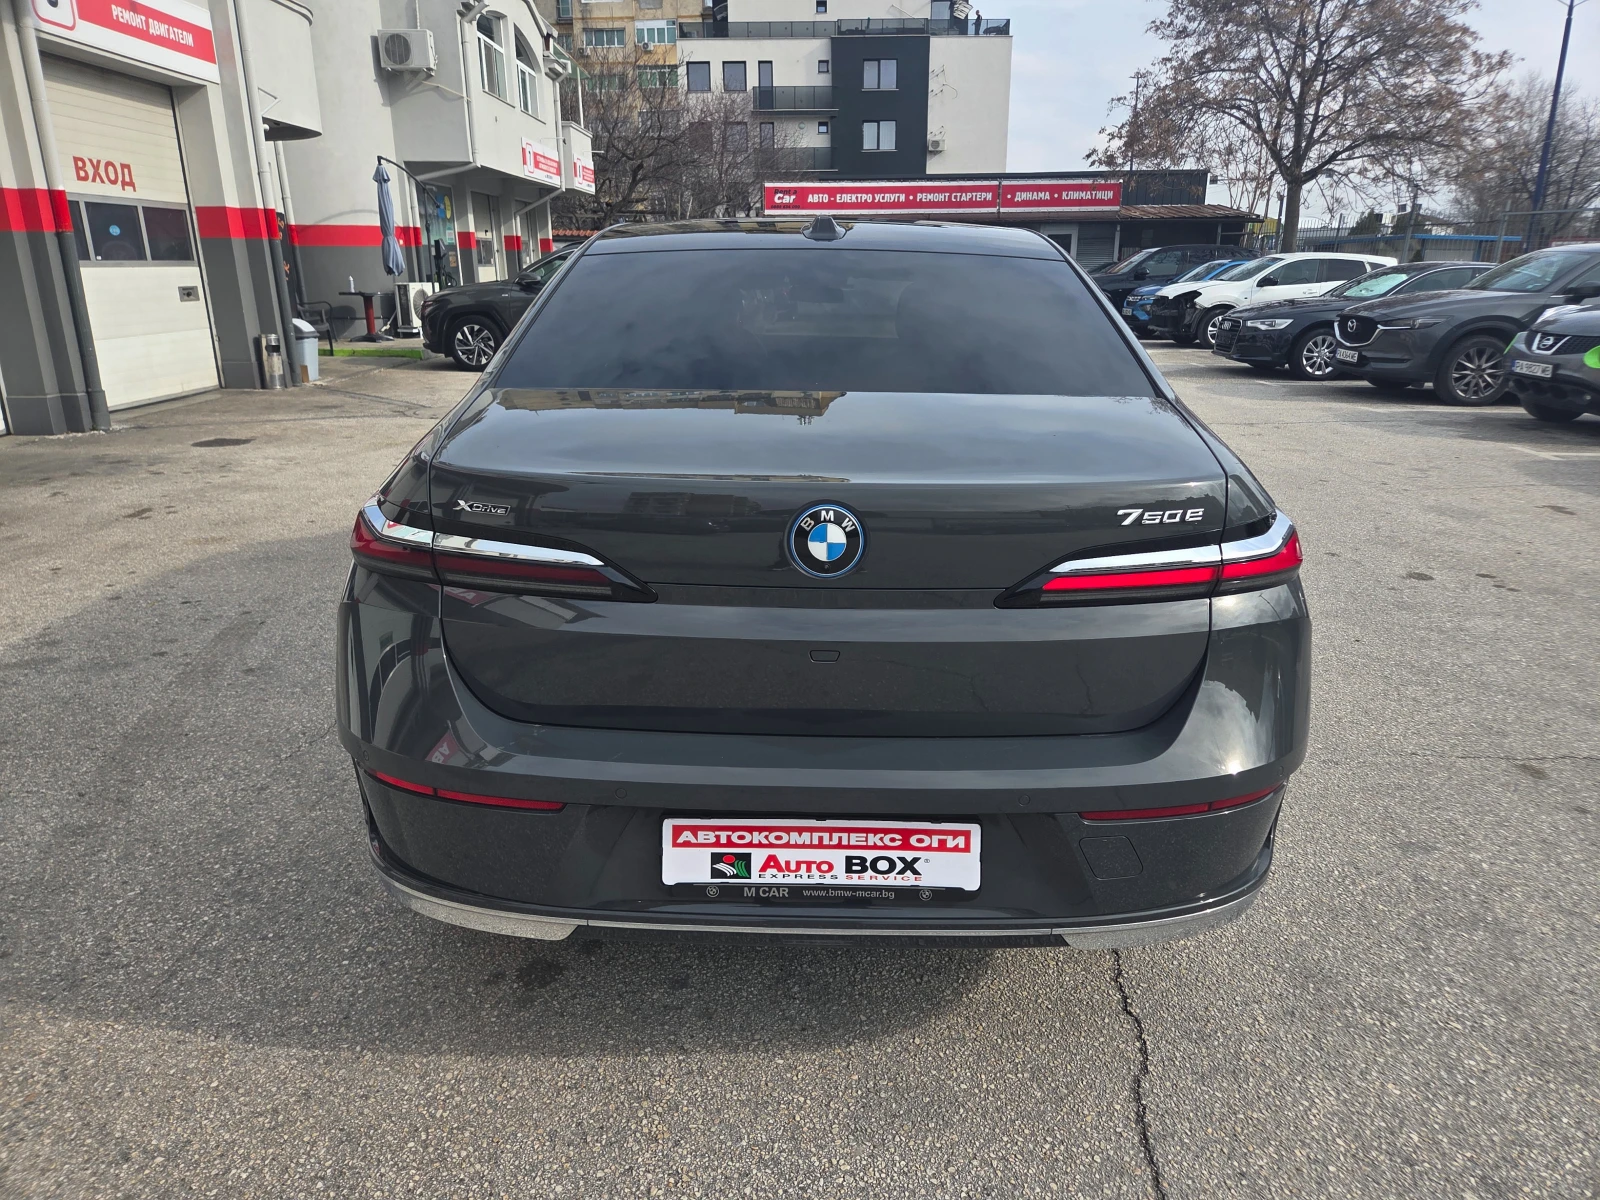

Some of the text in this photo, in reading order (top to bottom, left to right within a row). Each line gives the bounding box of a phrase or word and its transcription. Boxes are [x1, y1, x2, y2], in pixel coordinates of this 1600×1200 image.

[111, 5, 194, 47] РЕМОНТ ДВИГАТЕЛИ
[72, 155, 137, 192] ВХОД
[774, 193, 796, 204] Car
[807, 193, 829, 203] АВТО
[836, 193, 872, 203] ЕЛЕКТРО
[874, 193, 906, 203] УСЛУГИ
[916, 192, 949, 202] РЕМОНТ
[951, 192, 993, 202] СТАРТЕРИ
[1014, 190, 1114, 202] ДИНАМА КЛИМАТИЦИ
[800, 510, 856, 532] BMW
[676, 830, 966, 849] АВТОКОМПЛЕКС ОГИ
[743, 886, 895, 900] M CAR www.bmw-mcar.bg
